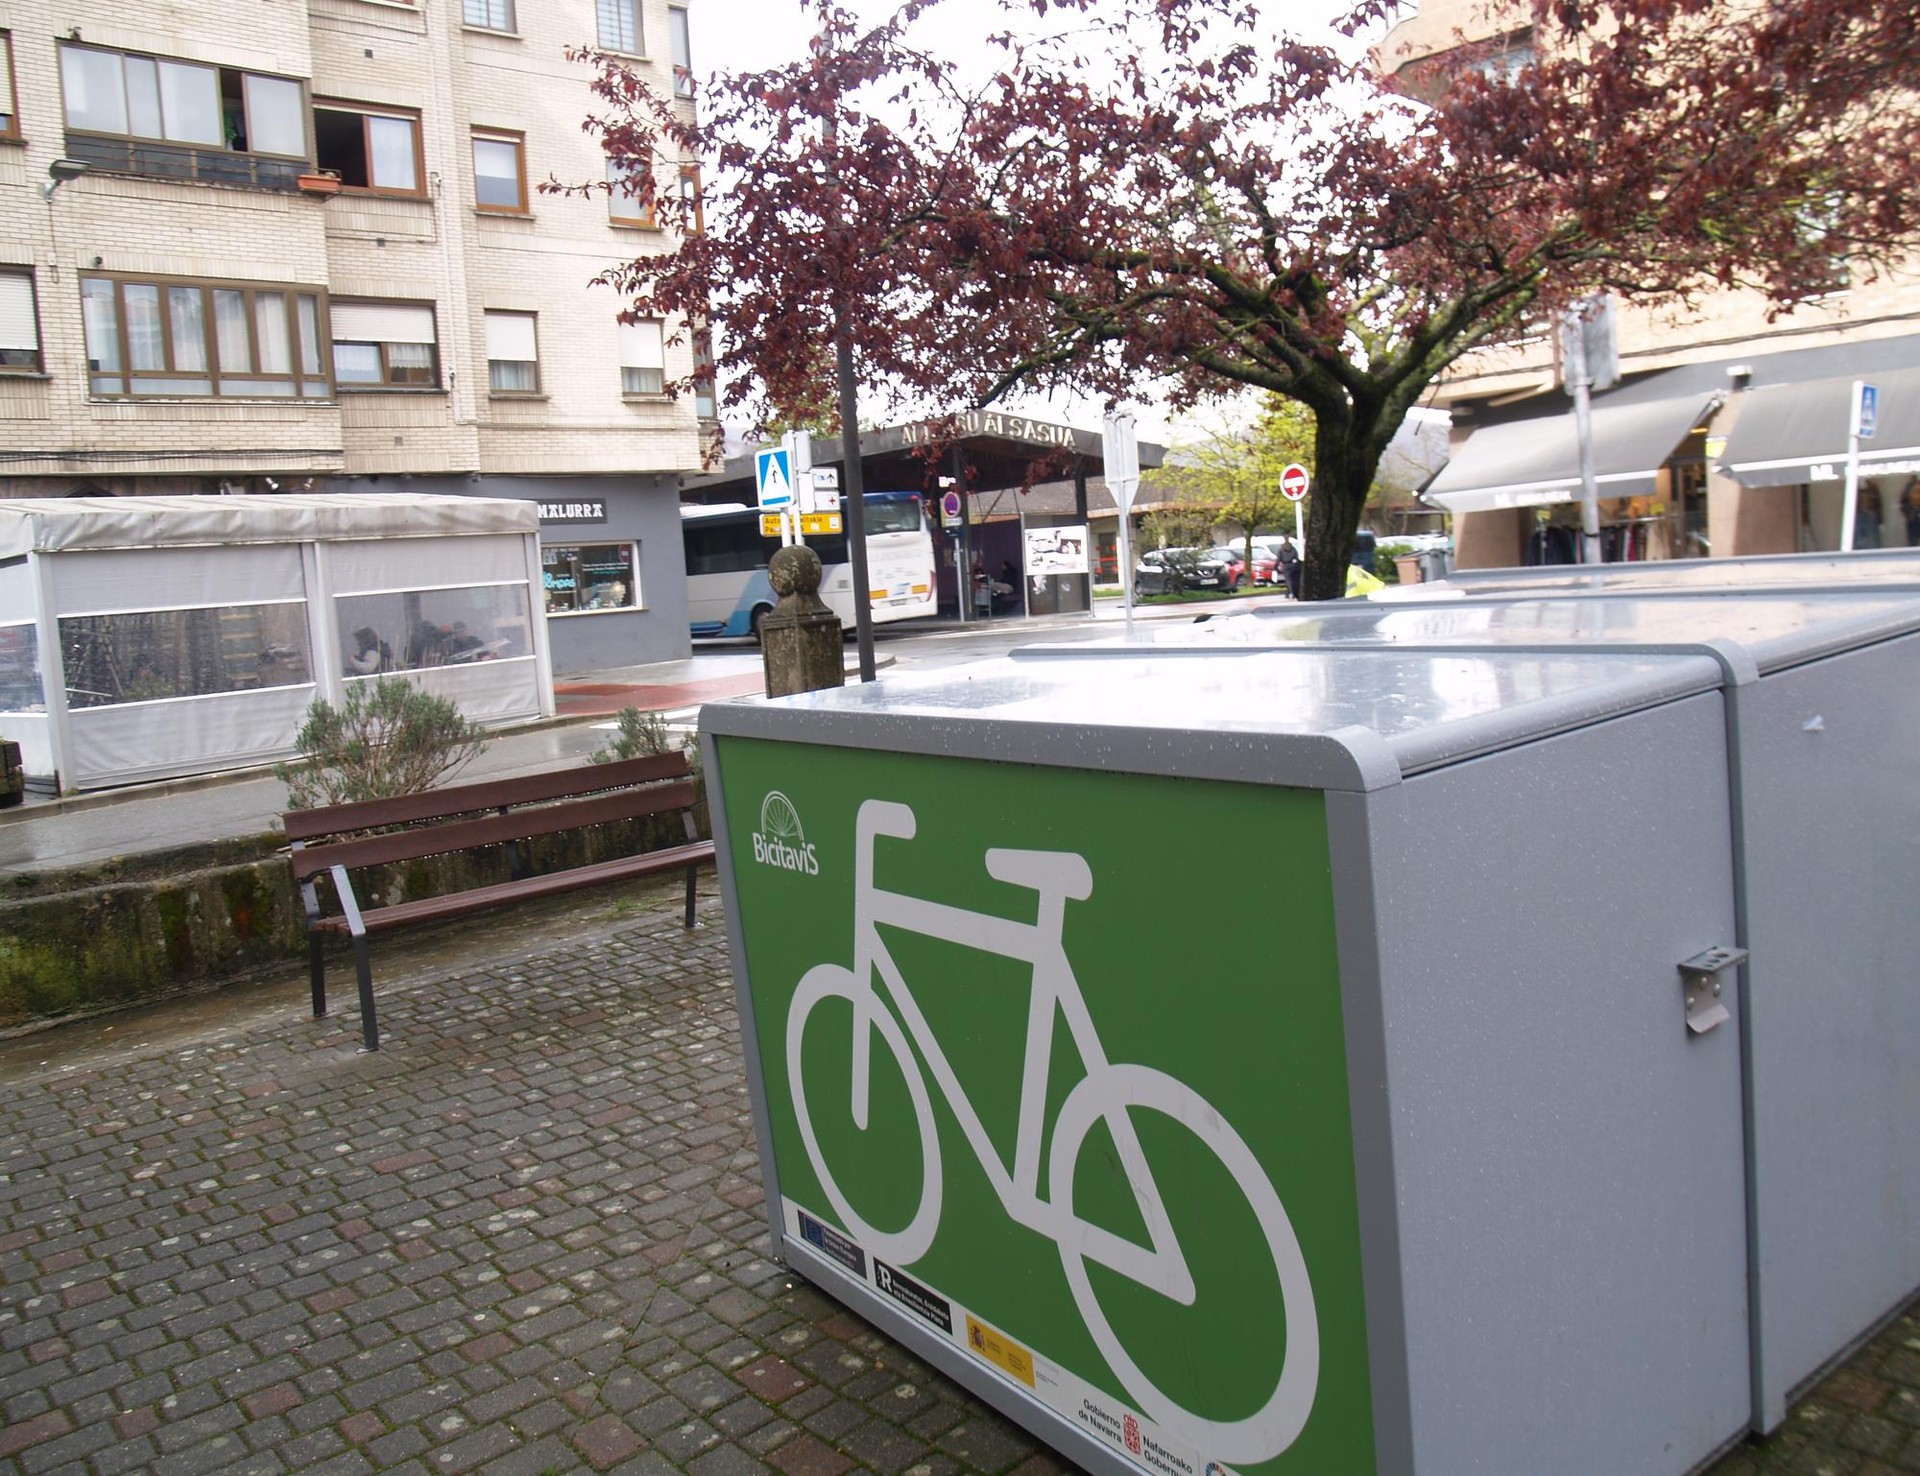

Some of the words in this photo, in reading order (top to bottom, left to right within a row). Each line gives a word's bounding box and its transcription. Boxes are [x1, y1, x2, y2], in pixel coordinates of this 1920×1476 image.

[1078, 1410, 1089, 1422] de
[1090, 1416, 1122, 1444] Navarra
[1083, 1399, 1121, 1429] Gobierno
[1143, 1435, 1193, 1474] Nafarroako
